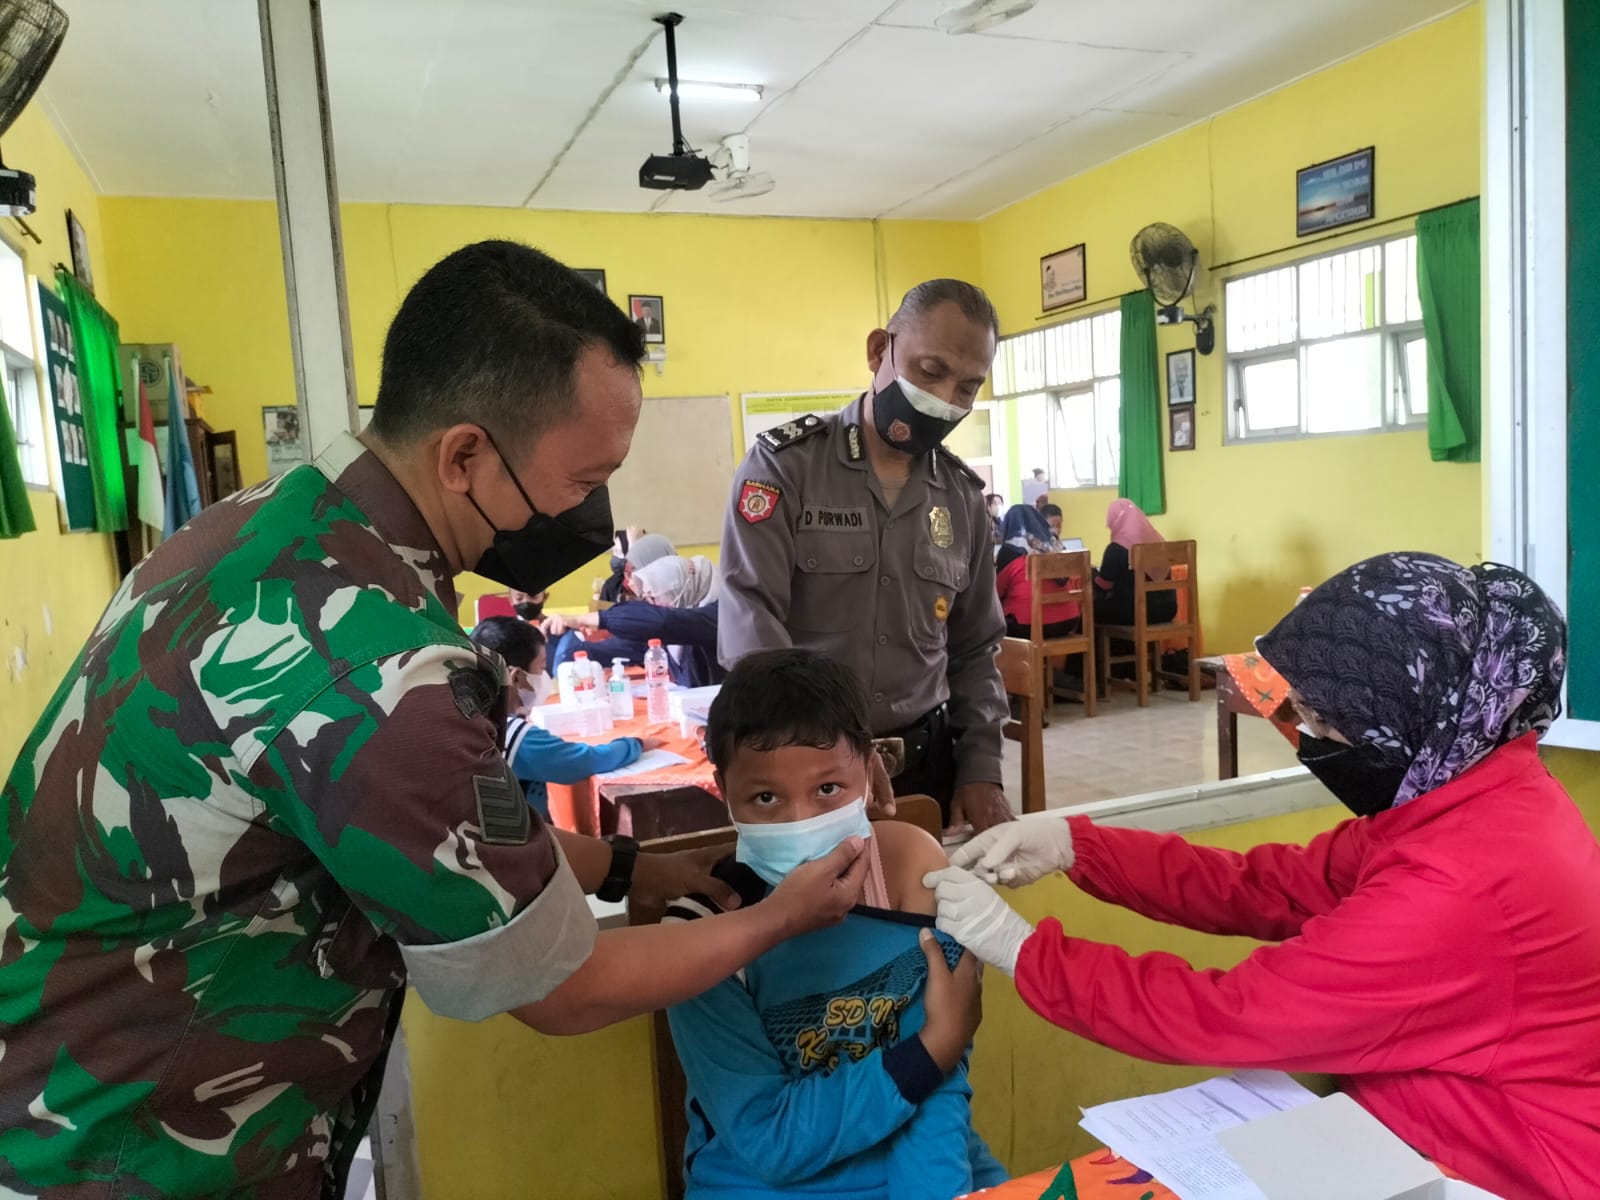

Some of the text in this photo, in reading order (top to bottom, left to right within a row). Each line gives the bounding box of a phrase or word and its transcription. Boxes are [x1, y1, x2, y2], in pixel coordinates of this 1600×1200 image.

[805, 510, 863, 527] D PURWADI
[825, 997, 866, 1027] SD
